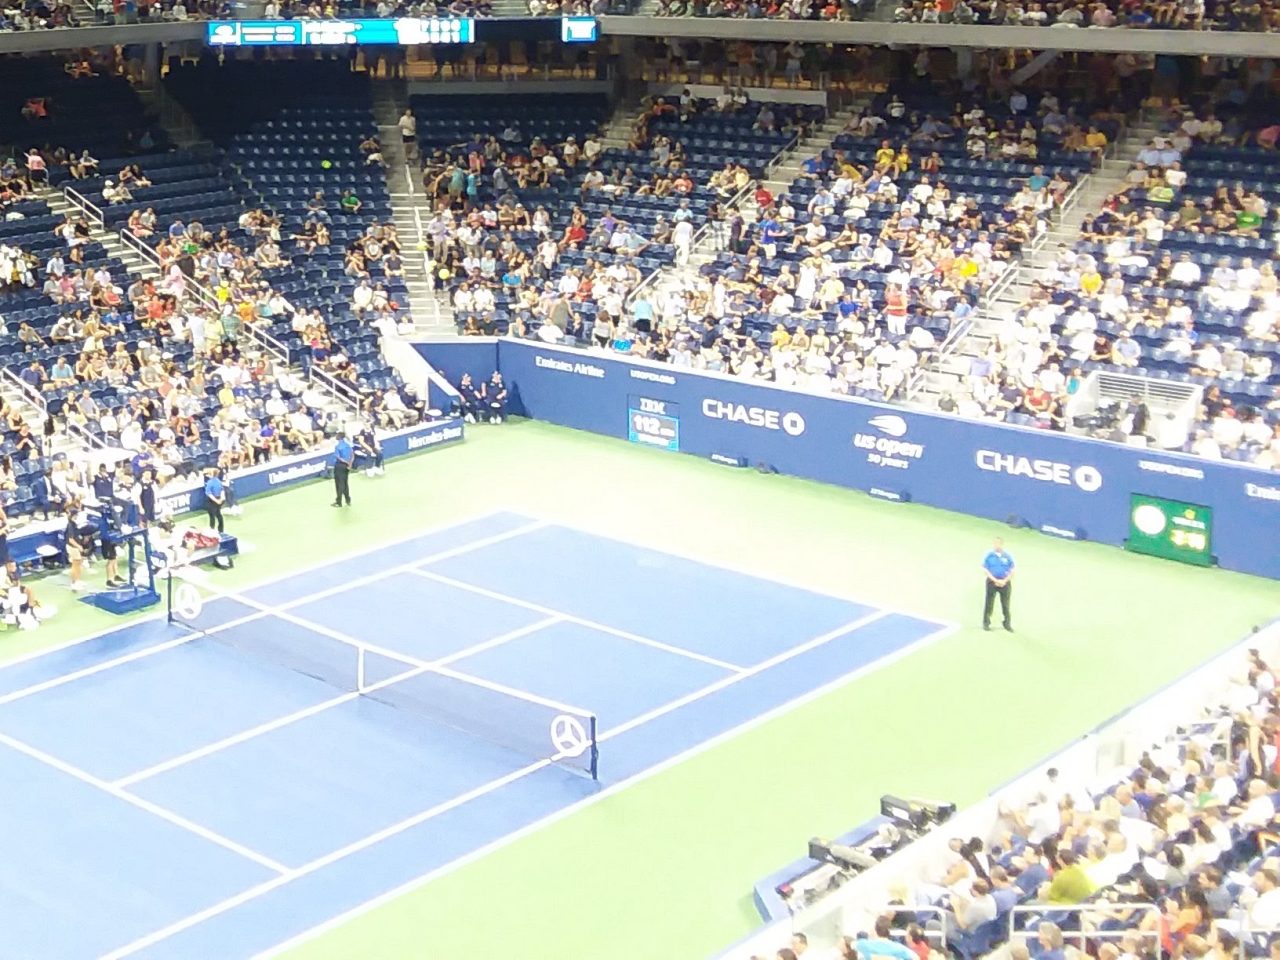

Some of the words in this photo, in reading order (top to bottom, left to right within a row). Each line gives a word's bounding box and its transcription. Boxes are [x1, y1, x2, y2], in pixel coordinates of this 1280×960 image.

[536, 356, 573, 373] Emirates
[574, 363, 605, 379] Airline
[640, 398, 666, 414] IBM
[702, 398, 780, 429] CHASE
[634, 415, 661, 435] 112
[876, 438, 924, 458] open
[880, 458, 909, 469] years
[976, 449, 1071, 485] CHASE
